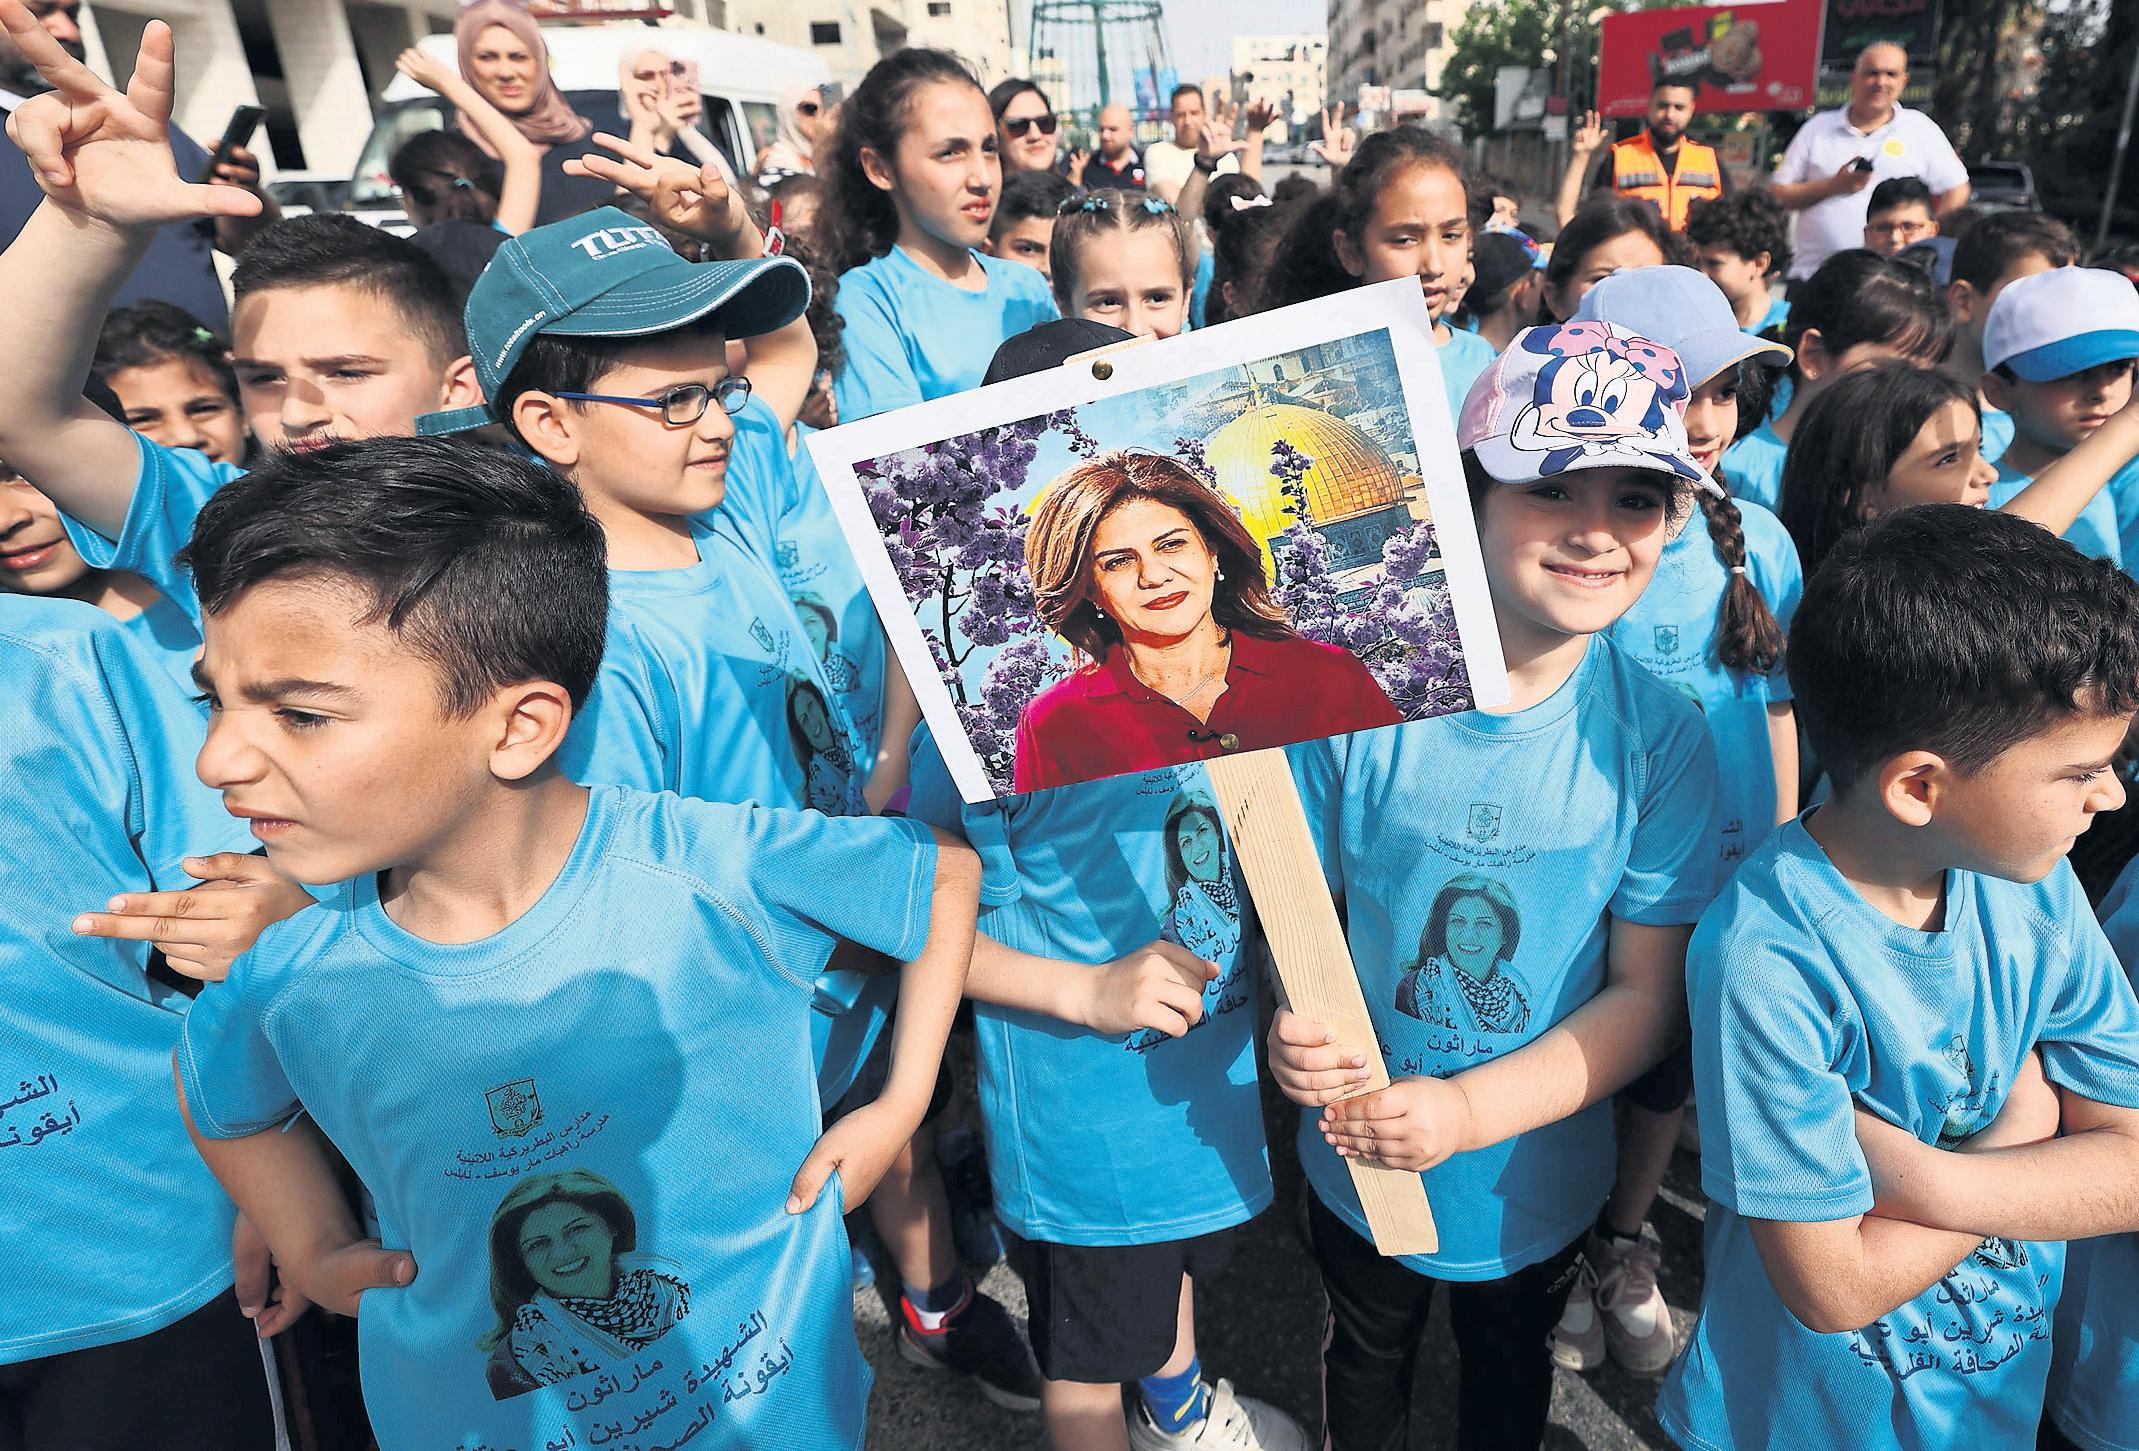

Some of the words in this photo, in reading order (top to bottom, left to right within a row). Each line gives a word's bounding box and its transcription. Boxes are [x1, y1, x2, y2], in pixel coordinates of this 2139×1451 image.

[1427, 1033, 1493, 1057] ماراثون
[559, 1110, 592, 1138] مدارس
[579, 1113, 610, 1141] مدرسة
[456, 1149, 495, 1165] اللاتينية
[498, 1131, 556, 1160] البطريركية
[544, 1138, 581, 1161] راهبات
[443, 1167, 472, 1181] نابلس
[483, 1165, 520, 1180] يوسف
[524, 1158, 542, 1172] مار
[1902, 1311, 1934, 1345] أبو
[684, 1308, 769, 1394] الشهيدة
[1952, 1332, 2024, 1375] الصحافة
[722, 1336, 794, 1404] أيقونة
[566, 1358, 664, 1412] ماراثون
[588, 1388, 678, 1445] شيرين
